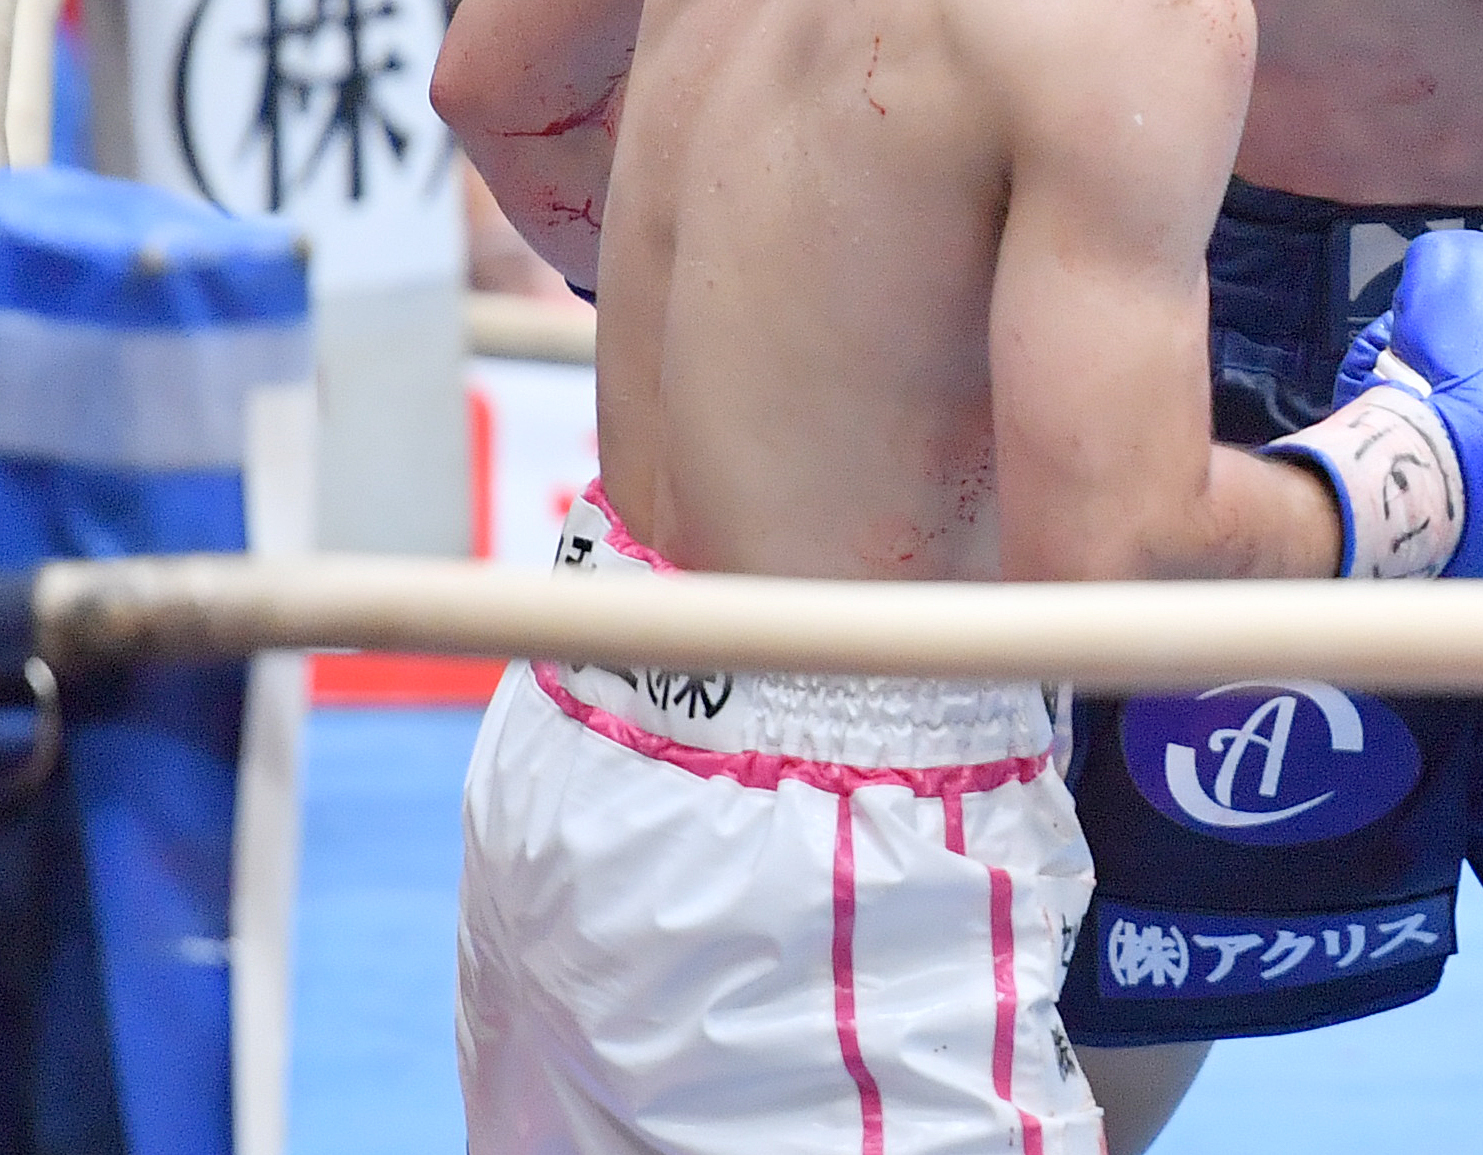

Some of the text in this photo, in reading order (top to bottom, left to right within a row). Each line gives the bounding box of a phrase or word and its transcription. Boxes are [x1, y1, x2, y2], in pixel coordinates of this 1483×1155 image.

[1107, 916, 1438, 988] (株)アクリス
